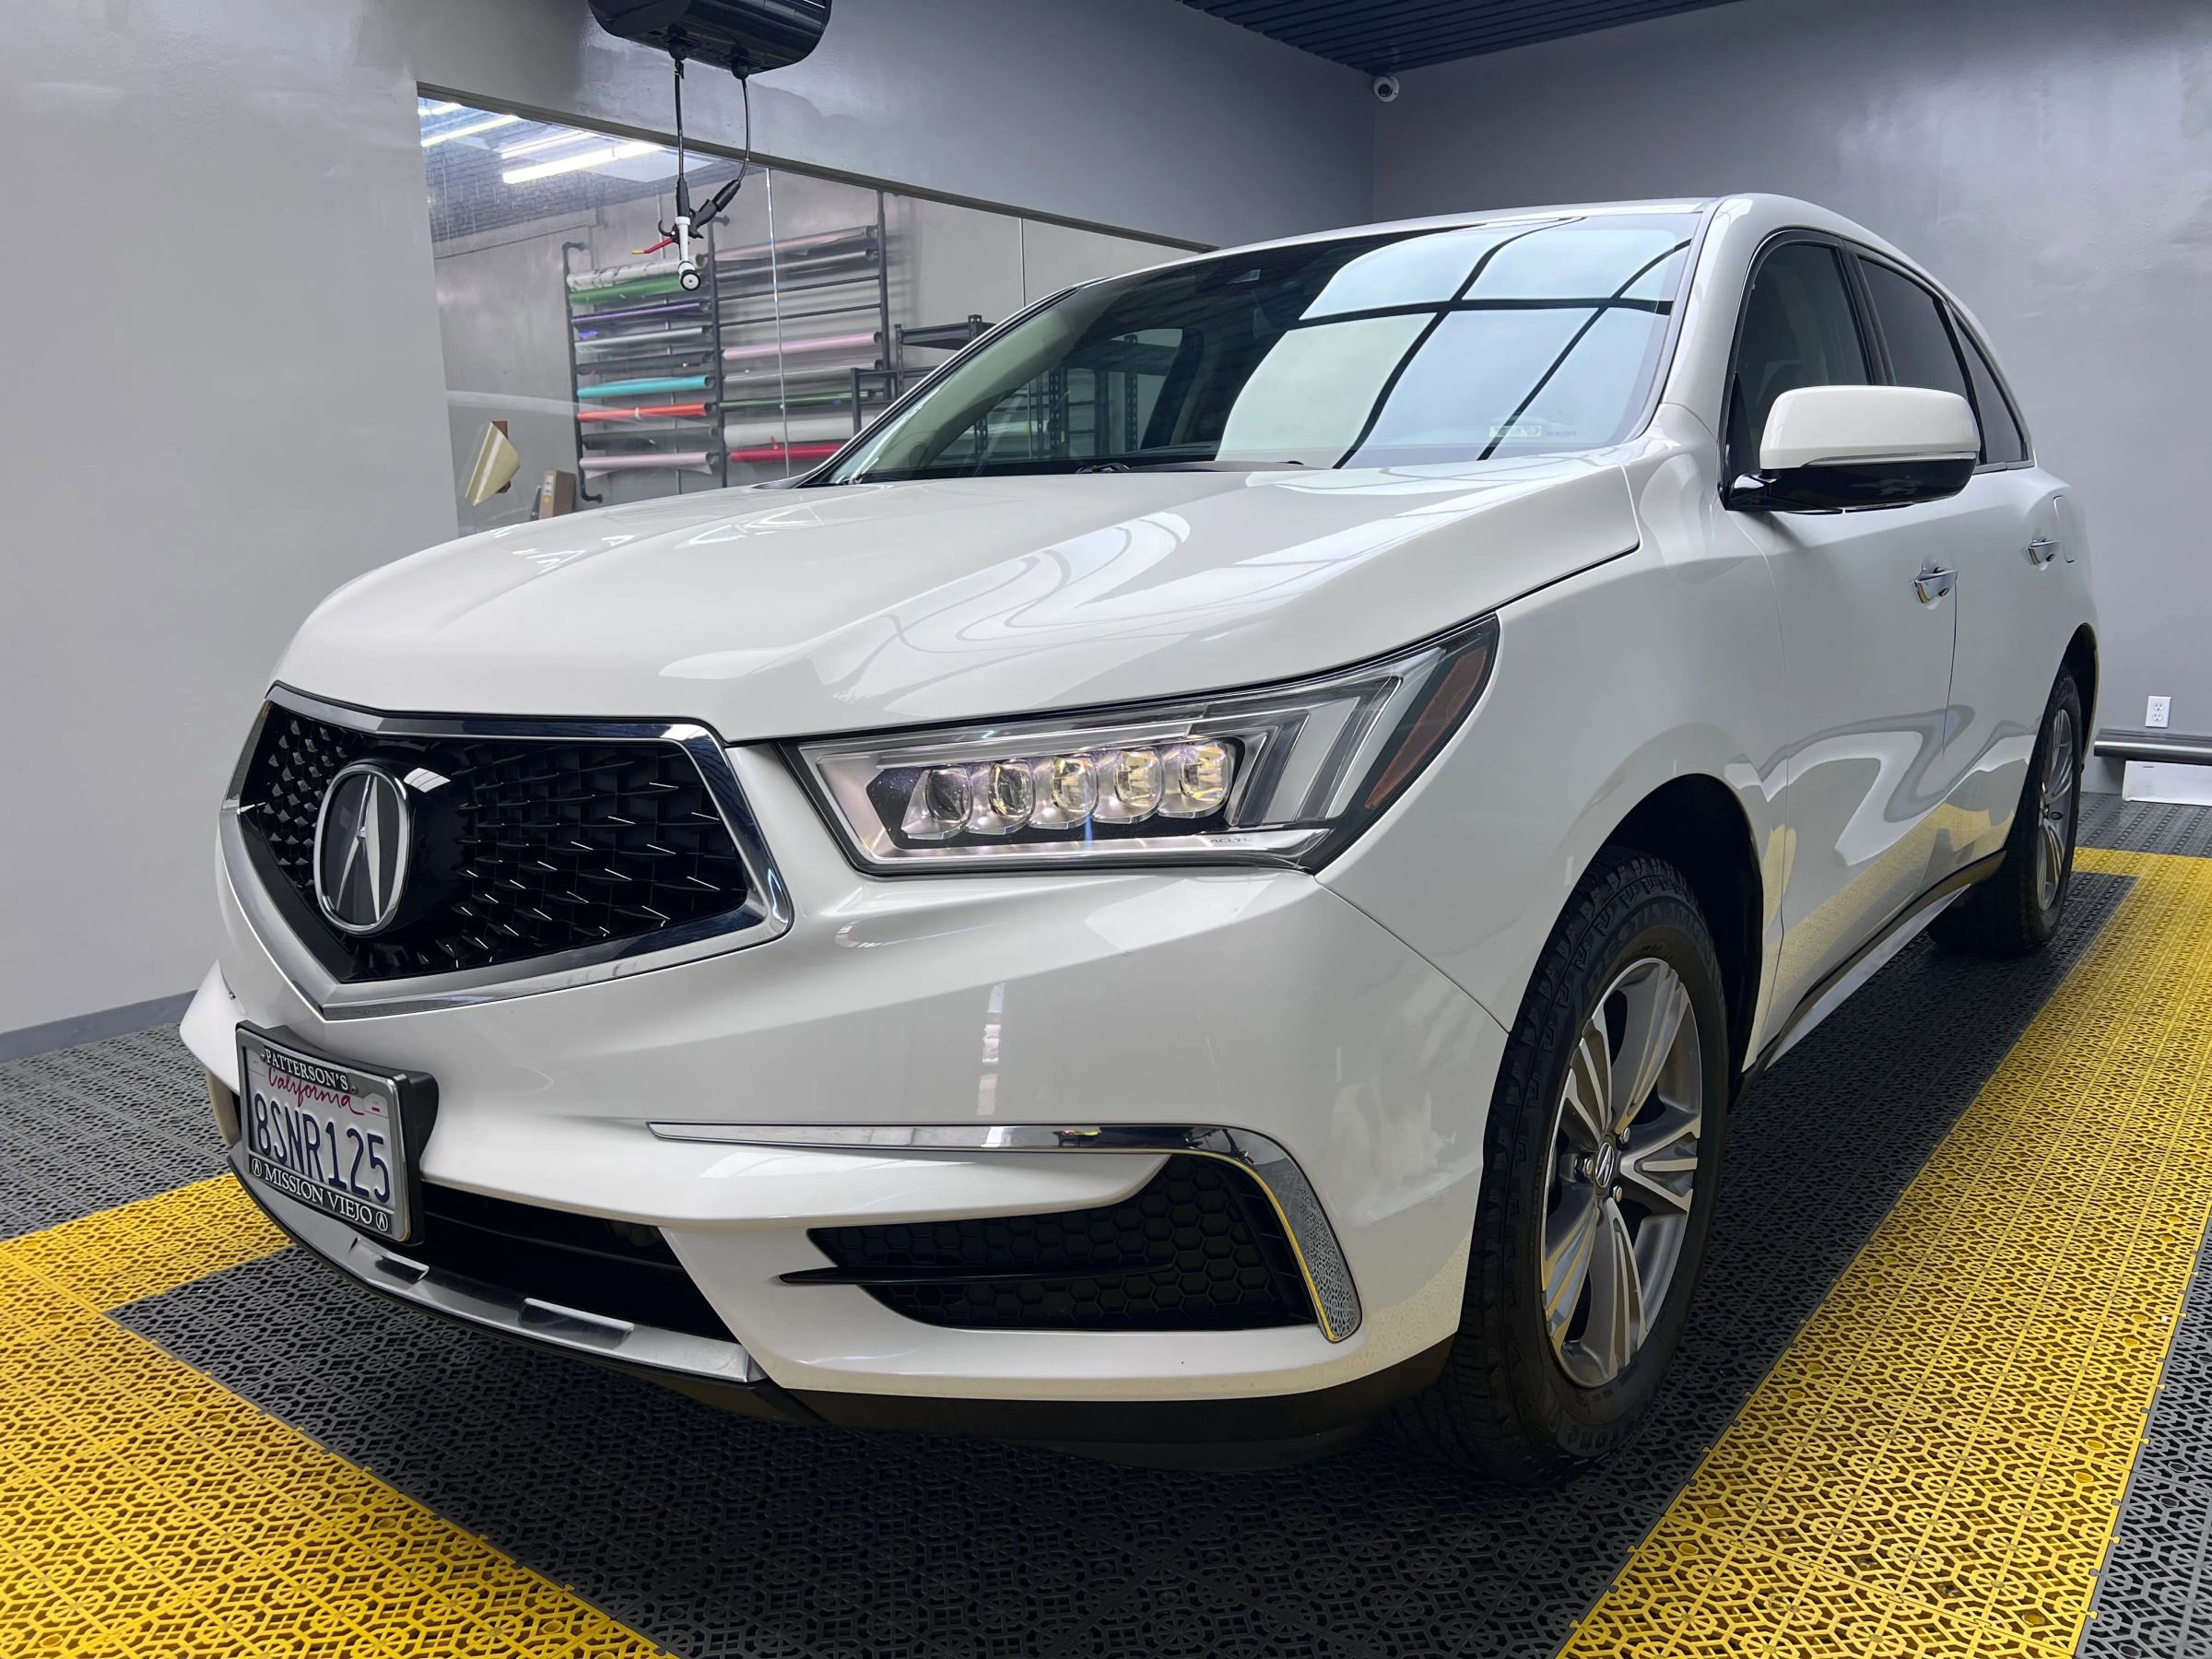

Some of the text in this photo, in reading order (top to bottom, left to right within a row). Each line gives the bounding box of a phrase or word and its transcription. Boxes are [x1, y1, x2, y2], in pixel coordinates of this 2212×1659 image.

[265, 1047, 349, 1091] PATTERSON'S
[268, 1067, 366, 1116] California
[253, 1092, 391, 1204] 8SNR125
[265, 1163, 373, 1225] MISSION VIEJO
